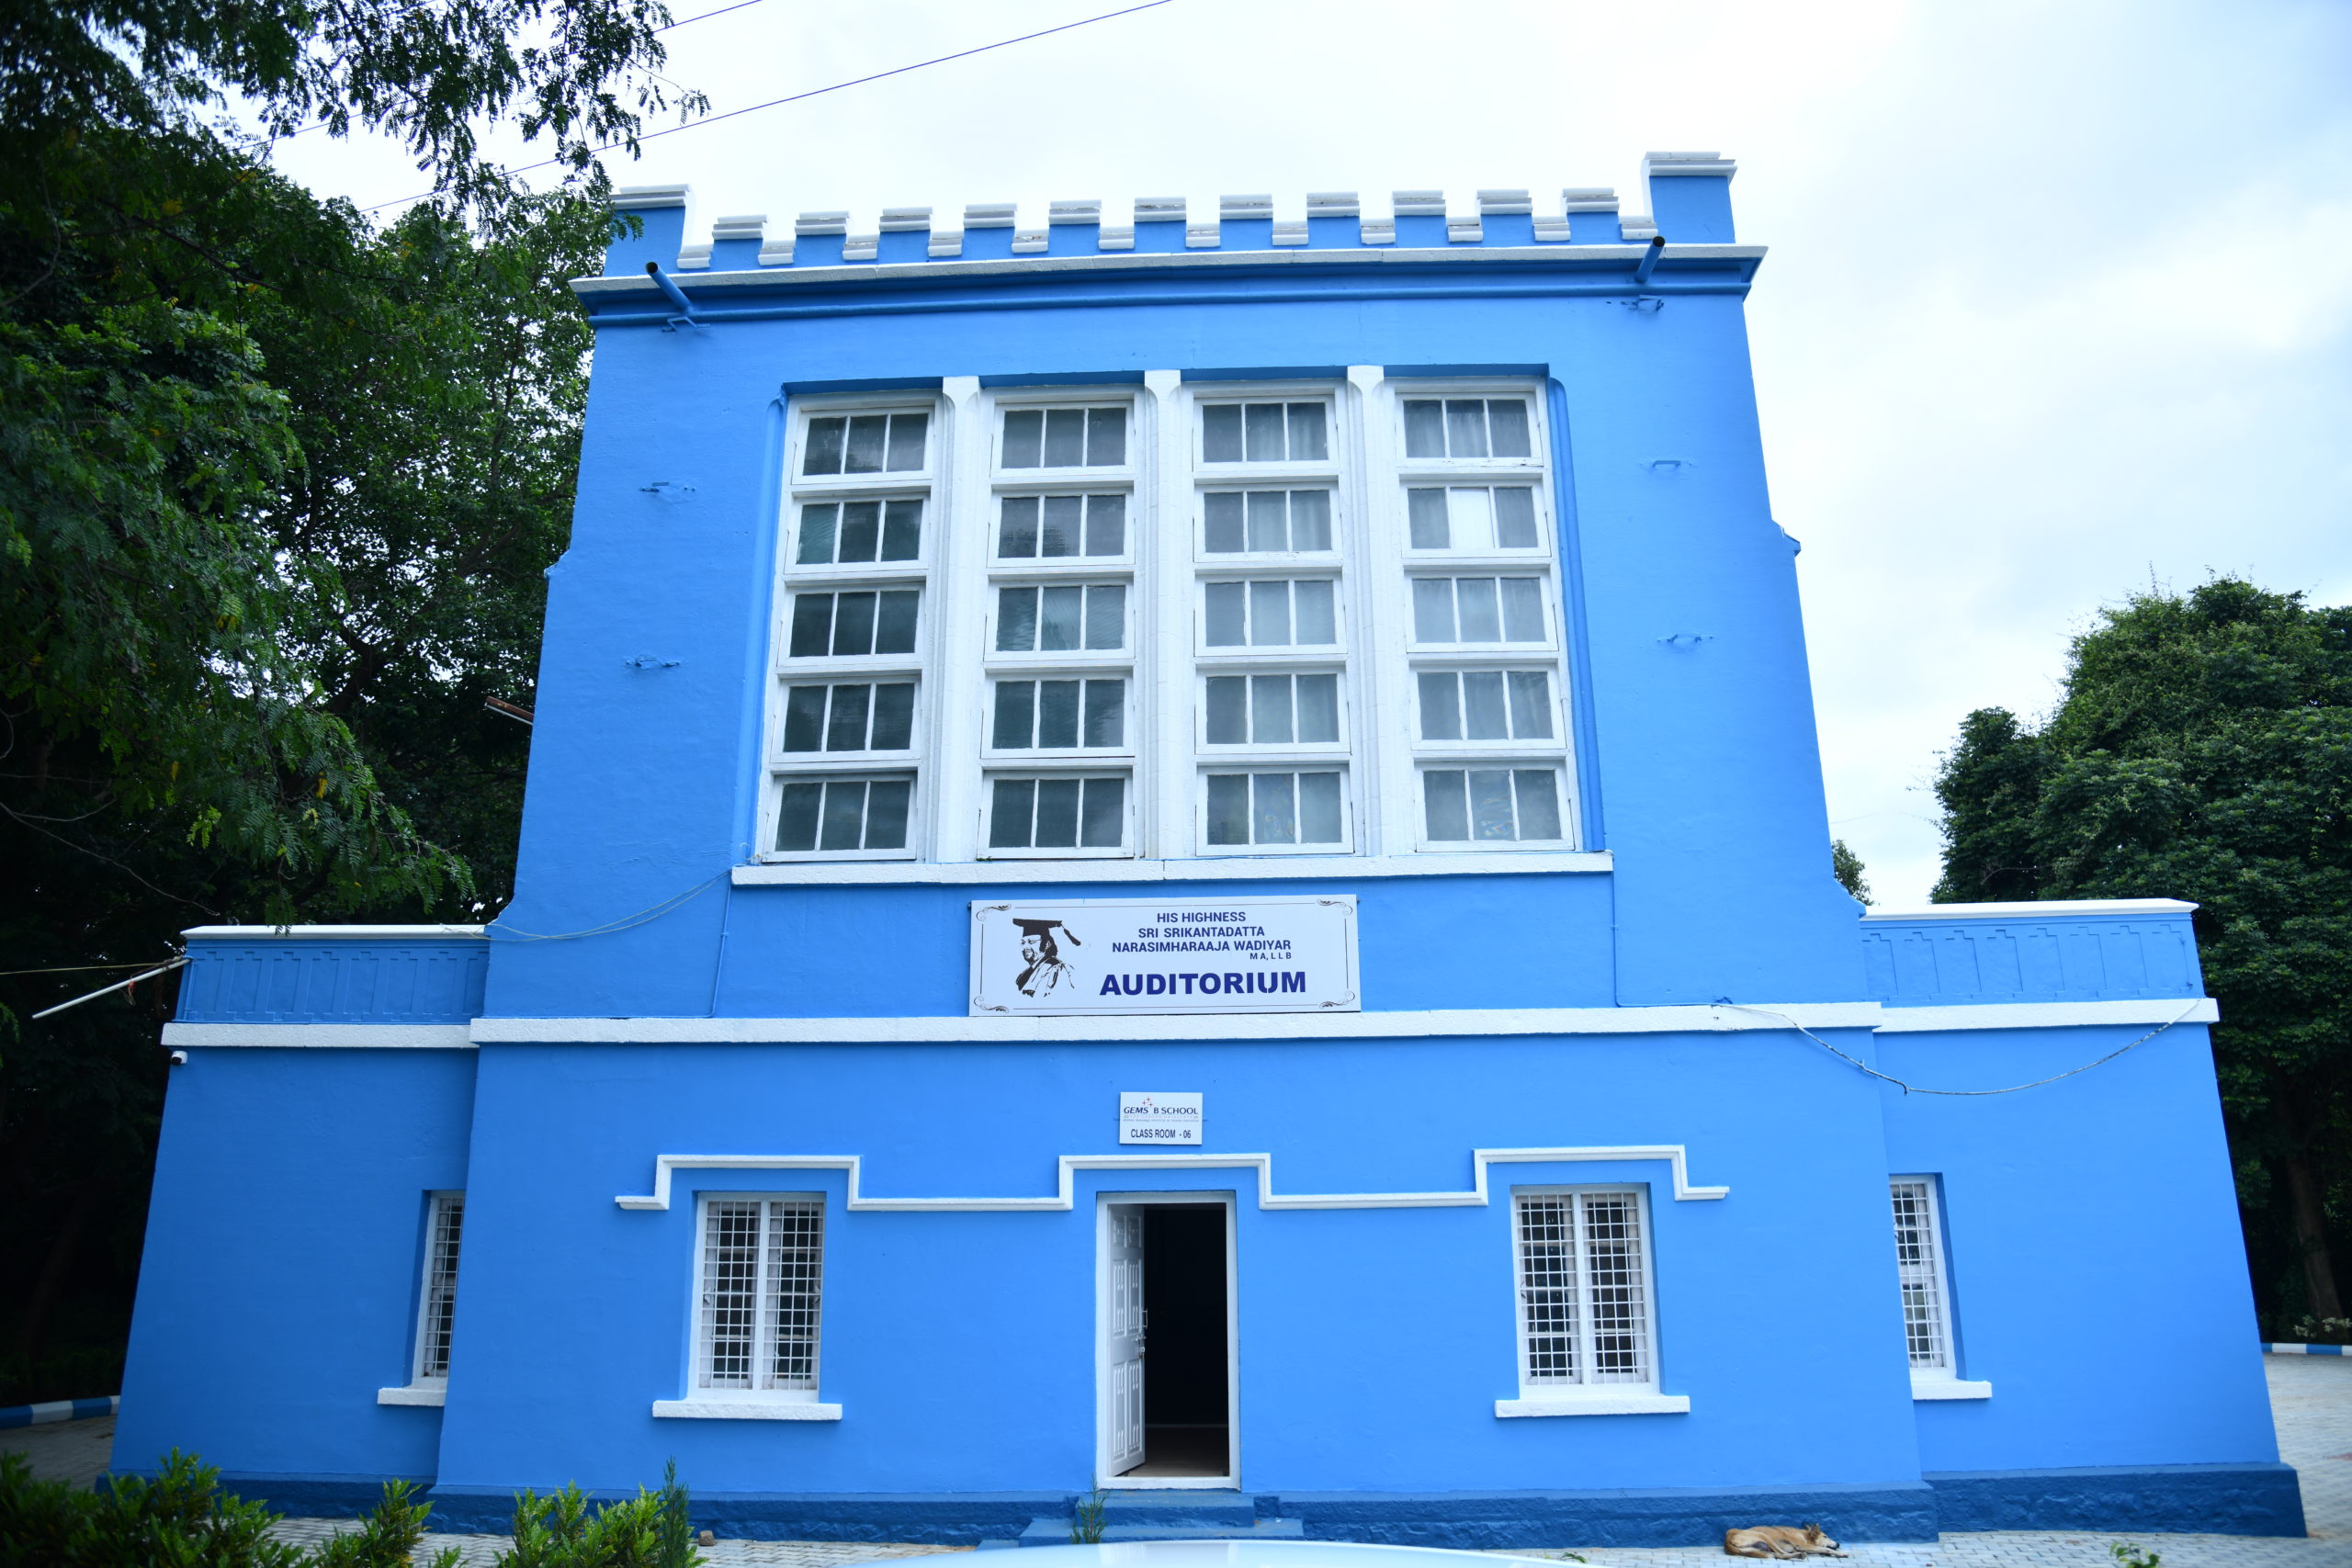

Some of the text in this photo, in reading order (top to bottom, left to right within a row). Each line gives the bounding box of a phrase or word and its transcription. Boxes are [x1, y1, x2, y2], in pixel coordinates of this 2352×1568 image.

[1157, 911, 1247, 923] HIS HIGHNESS
[1138, 926, 1265, 938] SRI SRIKANTADATTA
[1112, 940, 1292, 953] NARASIMHARAAJA WADIYAR
[1100, 972, 1306, 996] AUDITORIUM
[1124, 1106, 1149, 1114] GEMS
[1160, 1107, 1199, 1115] SCHOOL
[1130, 1128, 1153, 1138] CLASS
[1154, 1129, 1176, 1139] ROOM
[1182, 1130, 1192, 1139] 06
